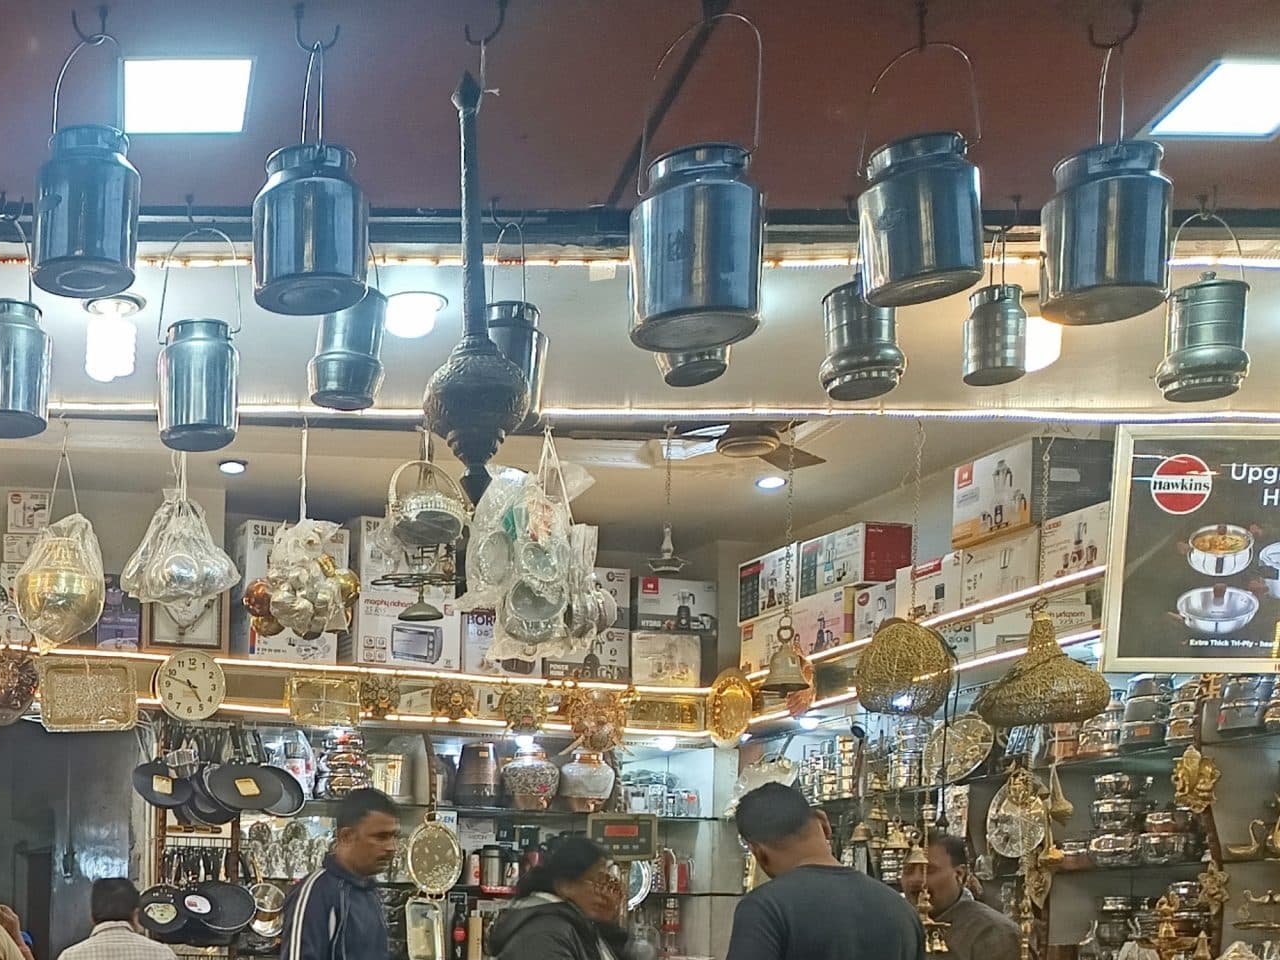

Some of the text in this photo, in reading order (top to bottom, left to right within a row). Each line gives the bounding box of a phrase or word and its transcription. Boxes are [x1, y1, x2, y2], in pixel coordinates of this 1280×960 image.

[1231, 463, 1280, 484] Upg
[1152, 478, 1210, 491] Hawkins
[253, 525, 277, 536] SUJ
